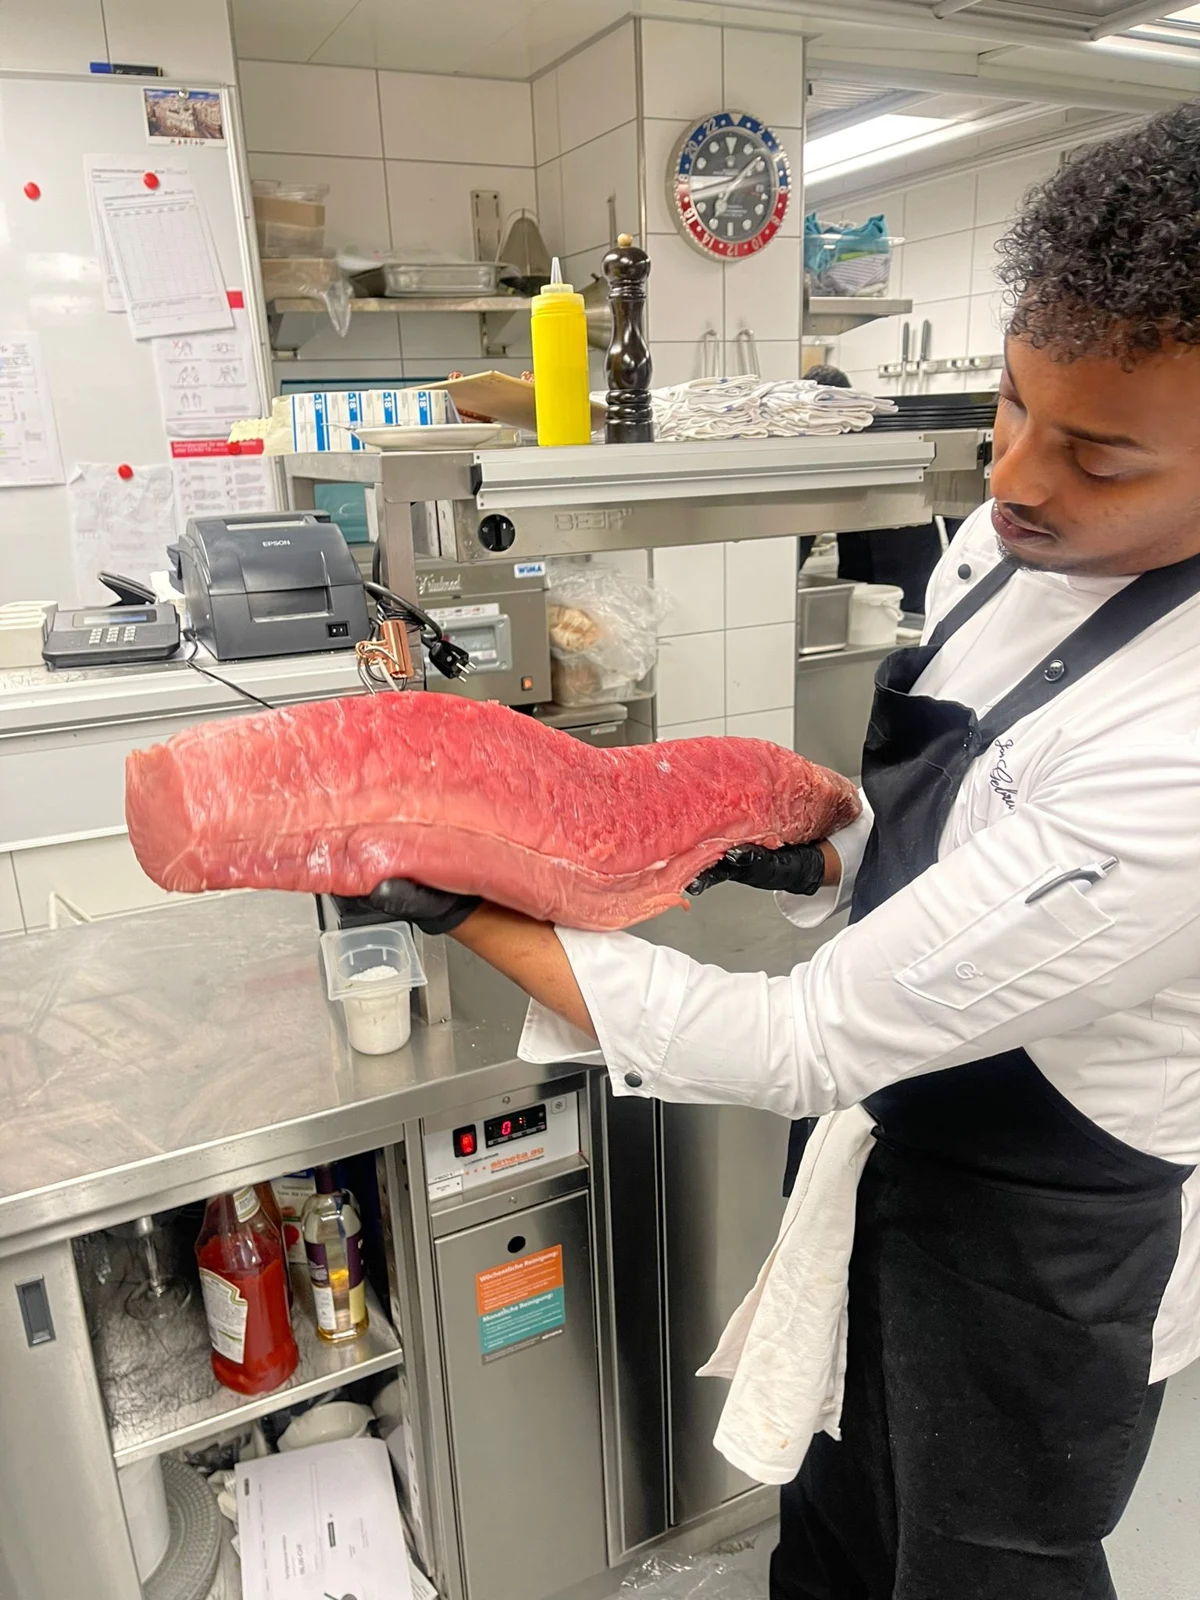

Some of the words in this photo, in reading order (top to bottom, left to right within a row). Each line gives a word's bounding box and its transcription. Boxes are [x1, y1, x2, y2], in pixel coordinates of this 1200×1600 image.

[702, 118, 719, 136] 22
[685, 140, 699, 159] 20
[684, 207, 698, 225] 16
[702, 233, 717, 249] 14
[727, 241, 739, 257] 12
[751, 236, 765, 250] 10
[262, 539, 291, 548] EPSON
[501, 1120, 512, 1136] 0
[479, 1262, 525, 1283] Wöchentliche
[482, 1304, 519, 1323] Monatliche
